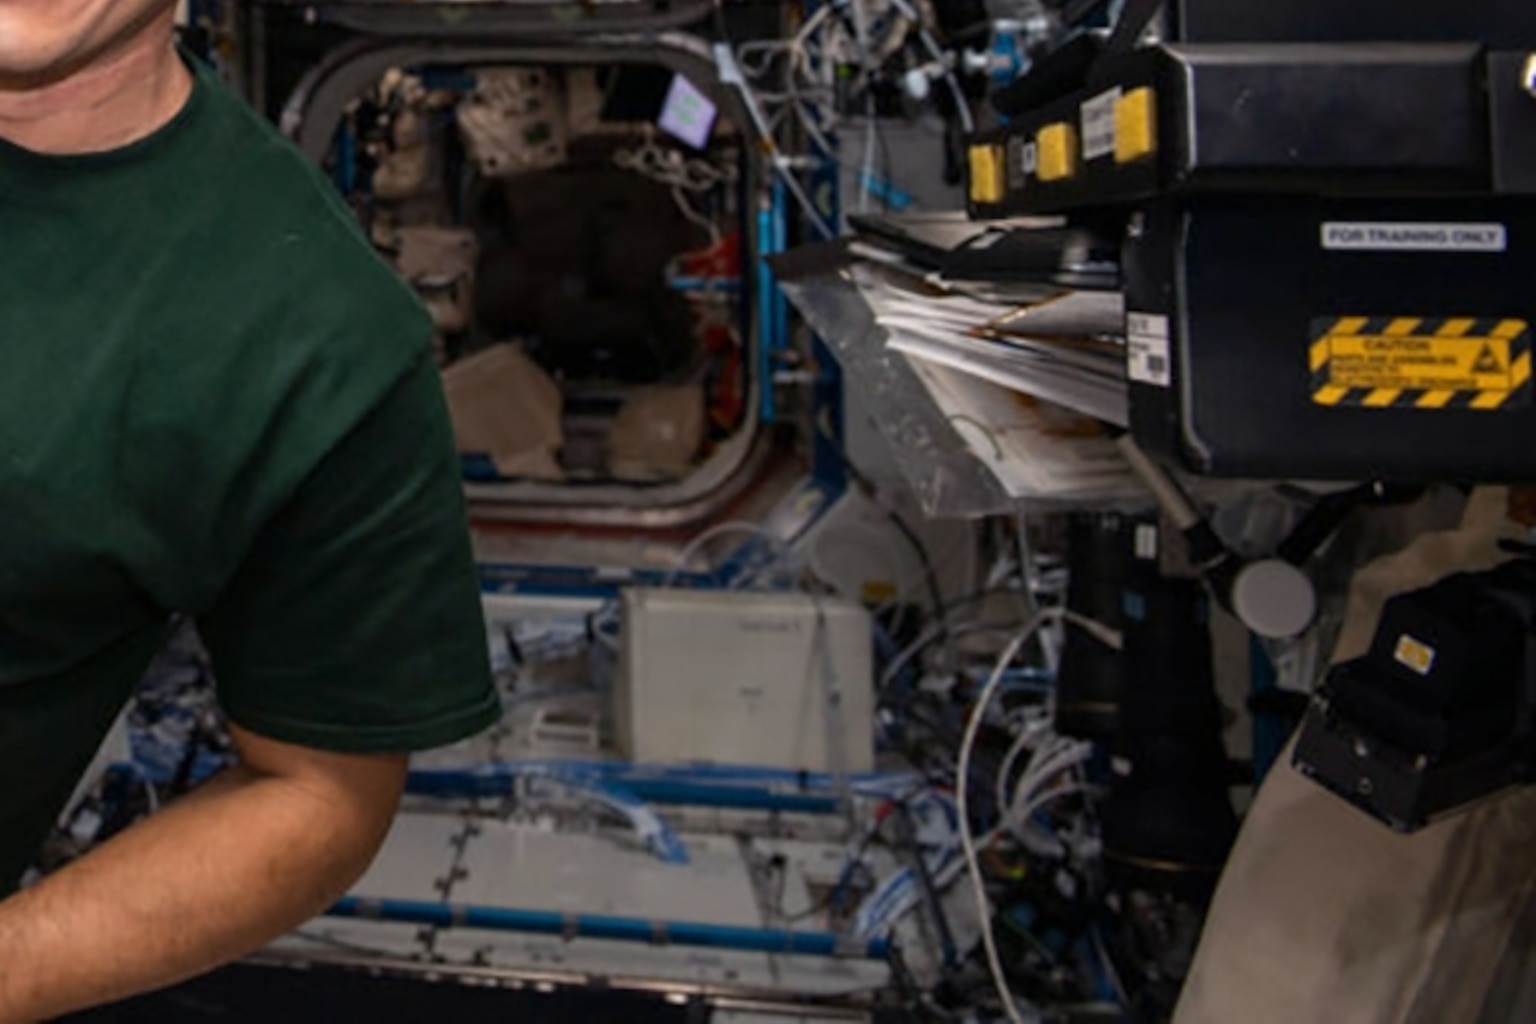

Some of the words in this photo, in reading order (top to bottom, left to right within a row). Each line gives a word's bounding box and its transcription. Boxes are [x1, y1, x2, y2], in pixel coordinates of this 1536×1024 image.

[1329, 229, 1363, 243] FOR
[1368, 229, 1447, 244] TRAINING
[1452, 230, 1498, 244] ONLY
[1363, 340, 1431, 351] CAUTION
